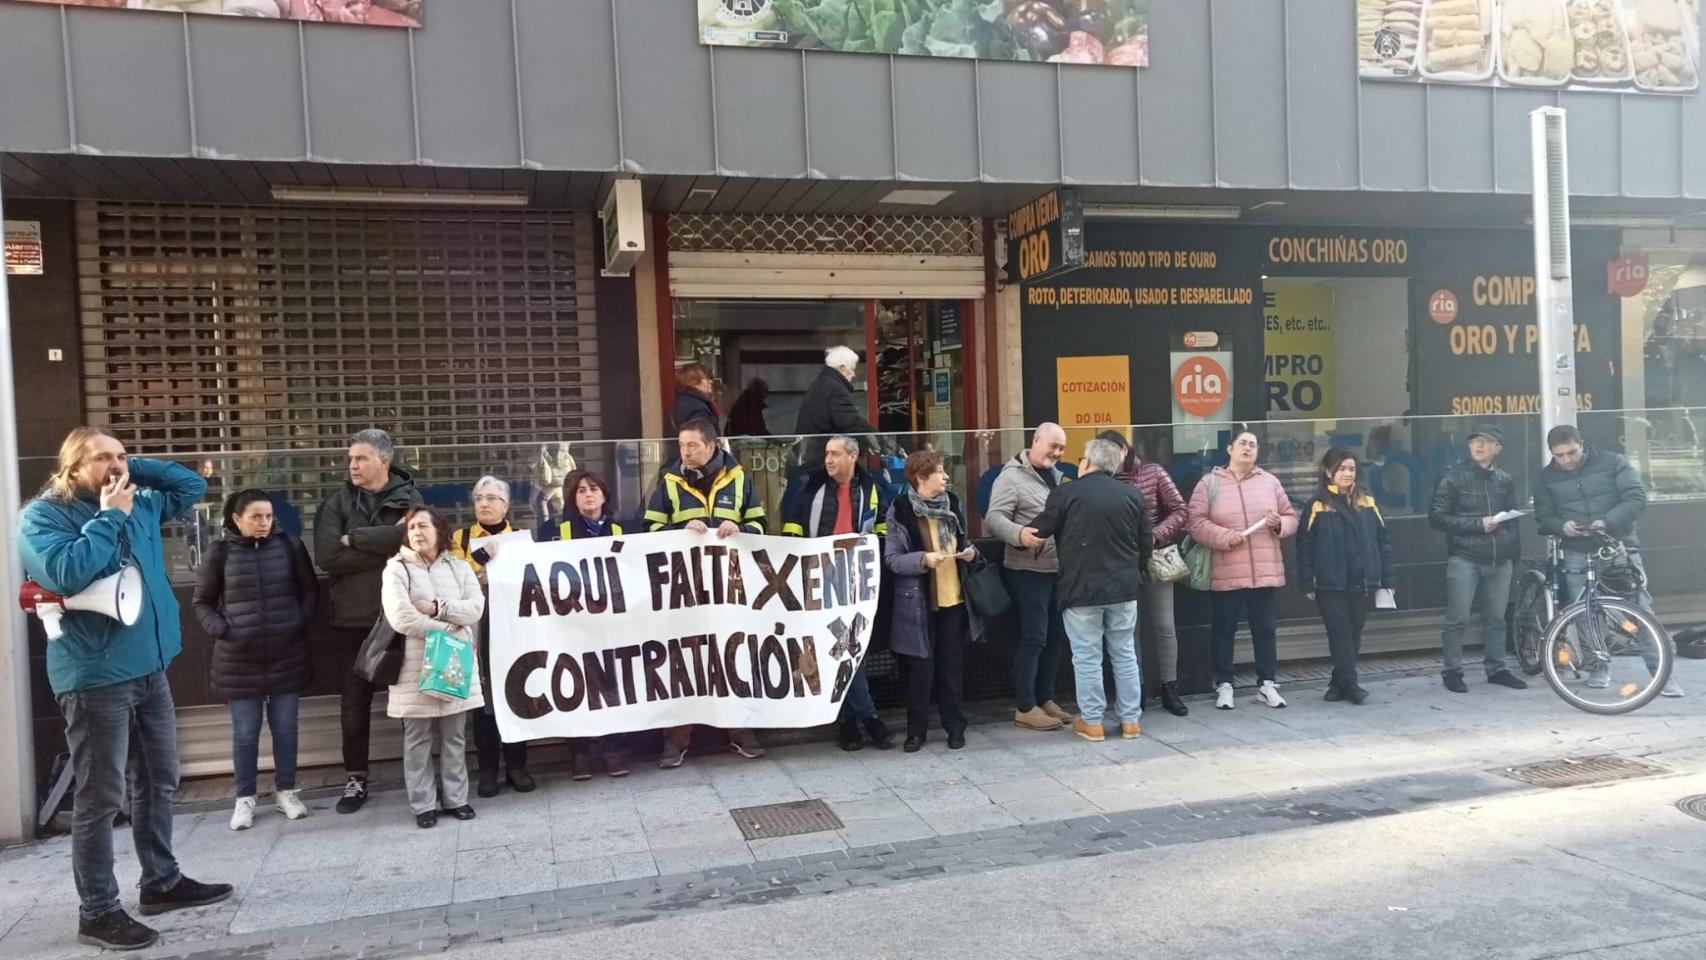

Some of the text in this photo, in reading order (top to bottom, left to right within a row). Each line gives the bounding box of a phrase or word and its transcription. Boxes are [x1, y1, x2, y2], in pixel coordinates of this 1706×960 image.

[1009, 190, 1059, 240] COMPRA VENTA
[1020, 230, 1050, 279] ORO
[1119, 251, 1146, 268] TODO
[1148, 251, 1171, 268] TIPO
[1174, 251, 1188, 268] DE
[1189, 251, 1217, 268] OURO
[1372, 239, 1408, 264] ORO
[1135, 287, 1169, 305] USADO
[1171, 287, 1178, 305] E
[1181, 287, 1253, 305] DESPARELLADO
[1433, 293, 1455, 312] ria
[1450, 325, 1498, 355] ORO
[1504, 325, 1519, 354] Y
[1062, 380, 1126, 393] COTIZACIÓN
[1181, 364, 1222, 394] ria
[1452, 396, 1503, 415] SOMOS
[1076, 413, 1091, 424] DO
[518, 537, 876, 617] AQUÍ FALTA XENTE
[505, 622, 821, 719] CONTRATACIÓN
